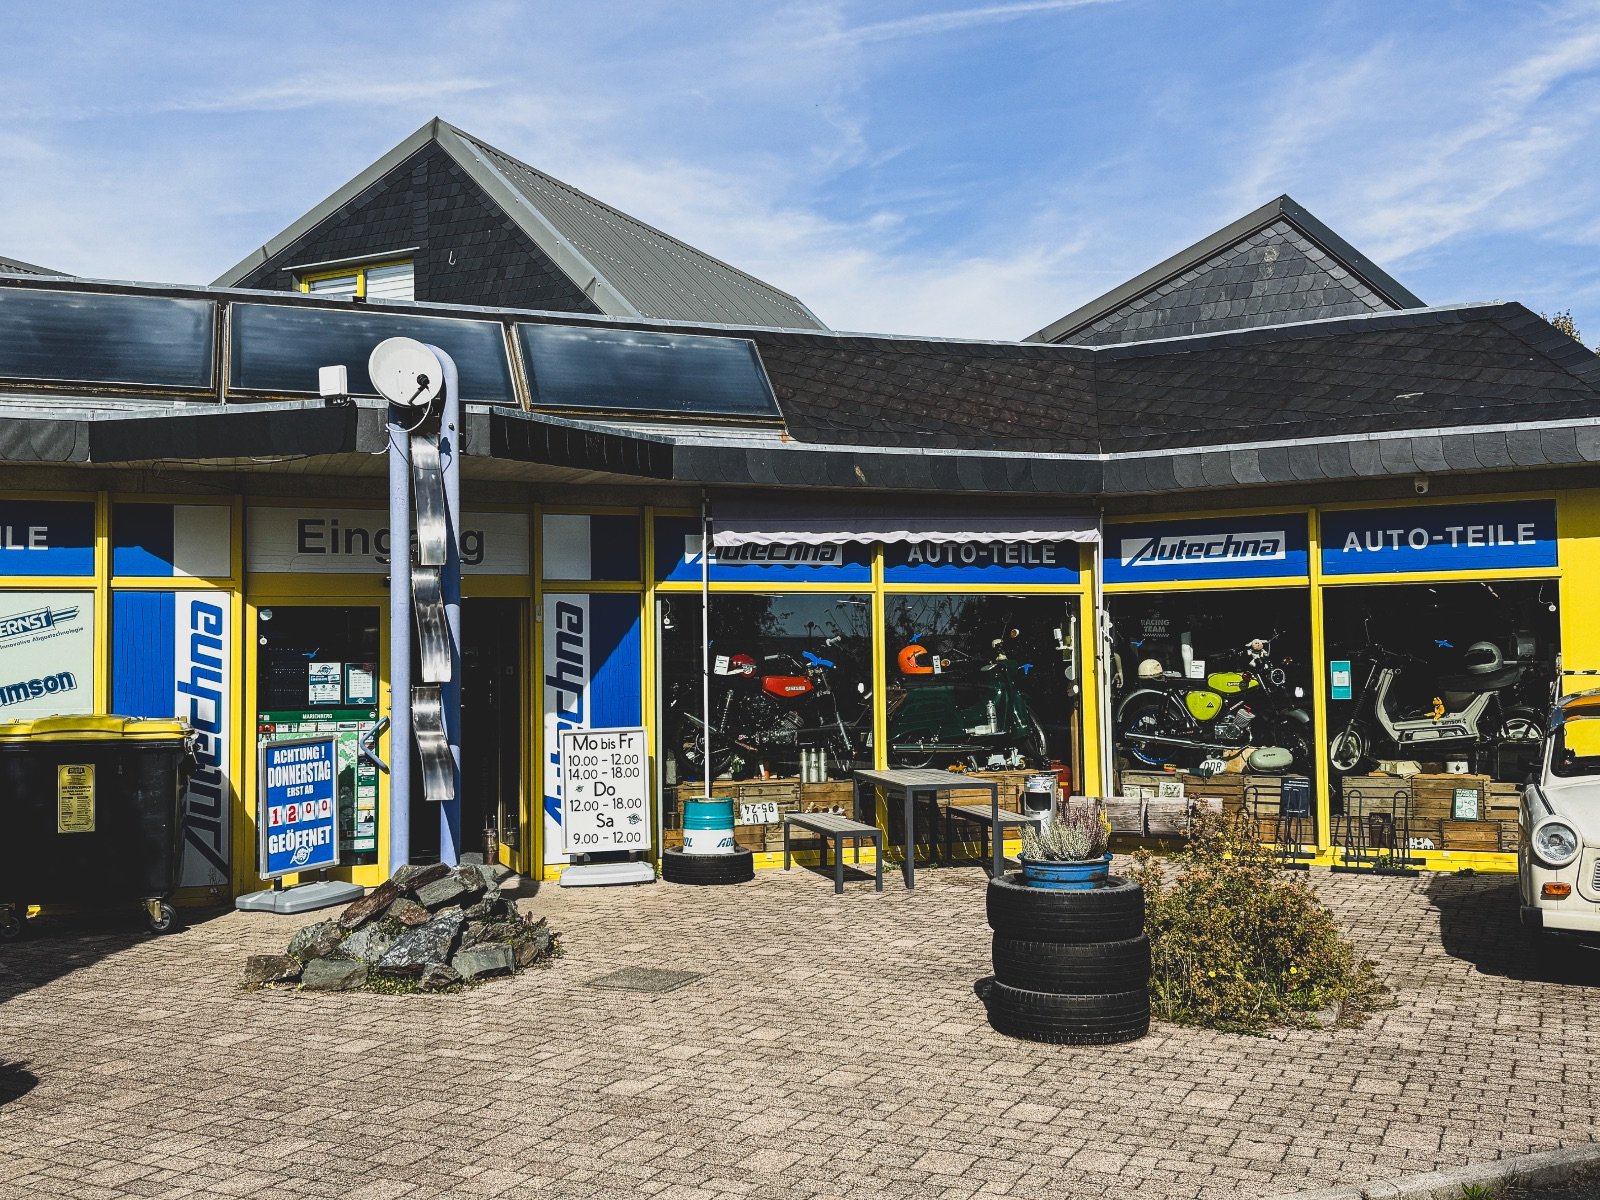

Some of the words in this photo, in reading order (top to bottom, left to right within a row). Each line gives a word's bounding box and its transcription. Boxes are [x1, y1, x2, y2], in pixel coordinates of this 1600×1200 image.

[297, 519, 484, 565] Eingg
[1342, 523, 1536, 553] AUTO-TEILE
[907, 543, 1056, 564] AUTO-TEILE
[1125, 535, 1280, 566] Autechna
[0, 612, 48, 637] ERNST
[573, 735, 598, 751] Mo
[600, 738, 616, 750] bis
[619, 733, 634, 749] Fr
[273, 746, 319, 765] ACHTUNG
[568, 754, 598, 767] 10.00
[610, 753, 639, 766] 12.00
[268, 760, 331, 788] DONNERSTAG
[568, 768, 598, 780] 14.00
[611, 767, 640, 779] 18.00
[287, 787, 304, 798] ERST
[304, 785, 314, 795] AB
[594, 781, 616, 797] Do
[569, 799, 599, 812] 12.00
[612, 797, 642, 810] 18.00
[596, 812, 614, 828] Sa
[268, 825, 332, 855] GEÖFFNET
[573, 833, 599, 845] 9.00
[612, 831, 641, 844] 12.00
